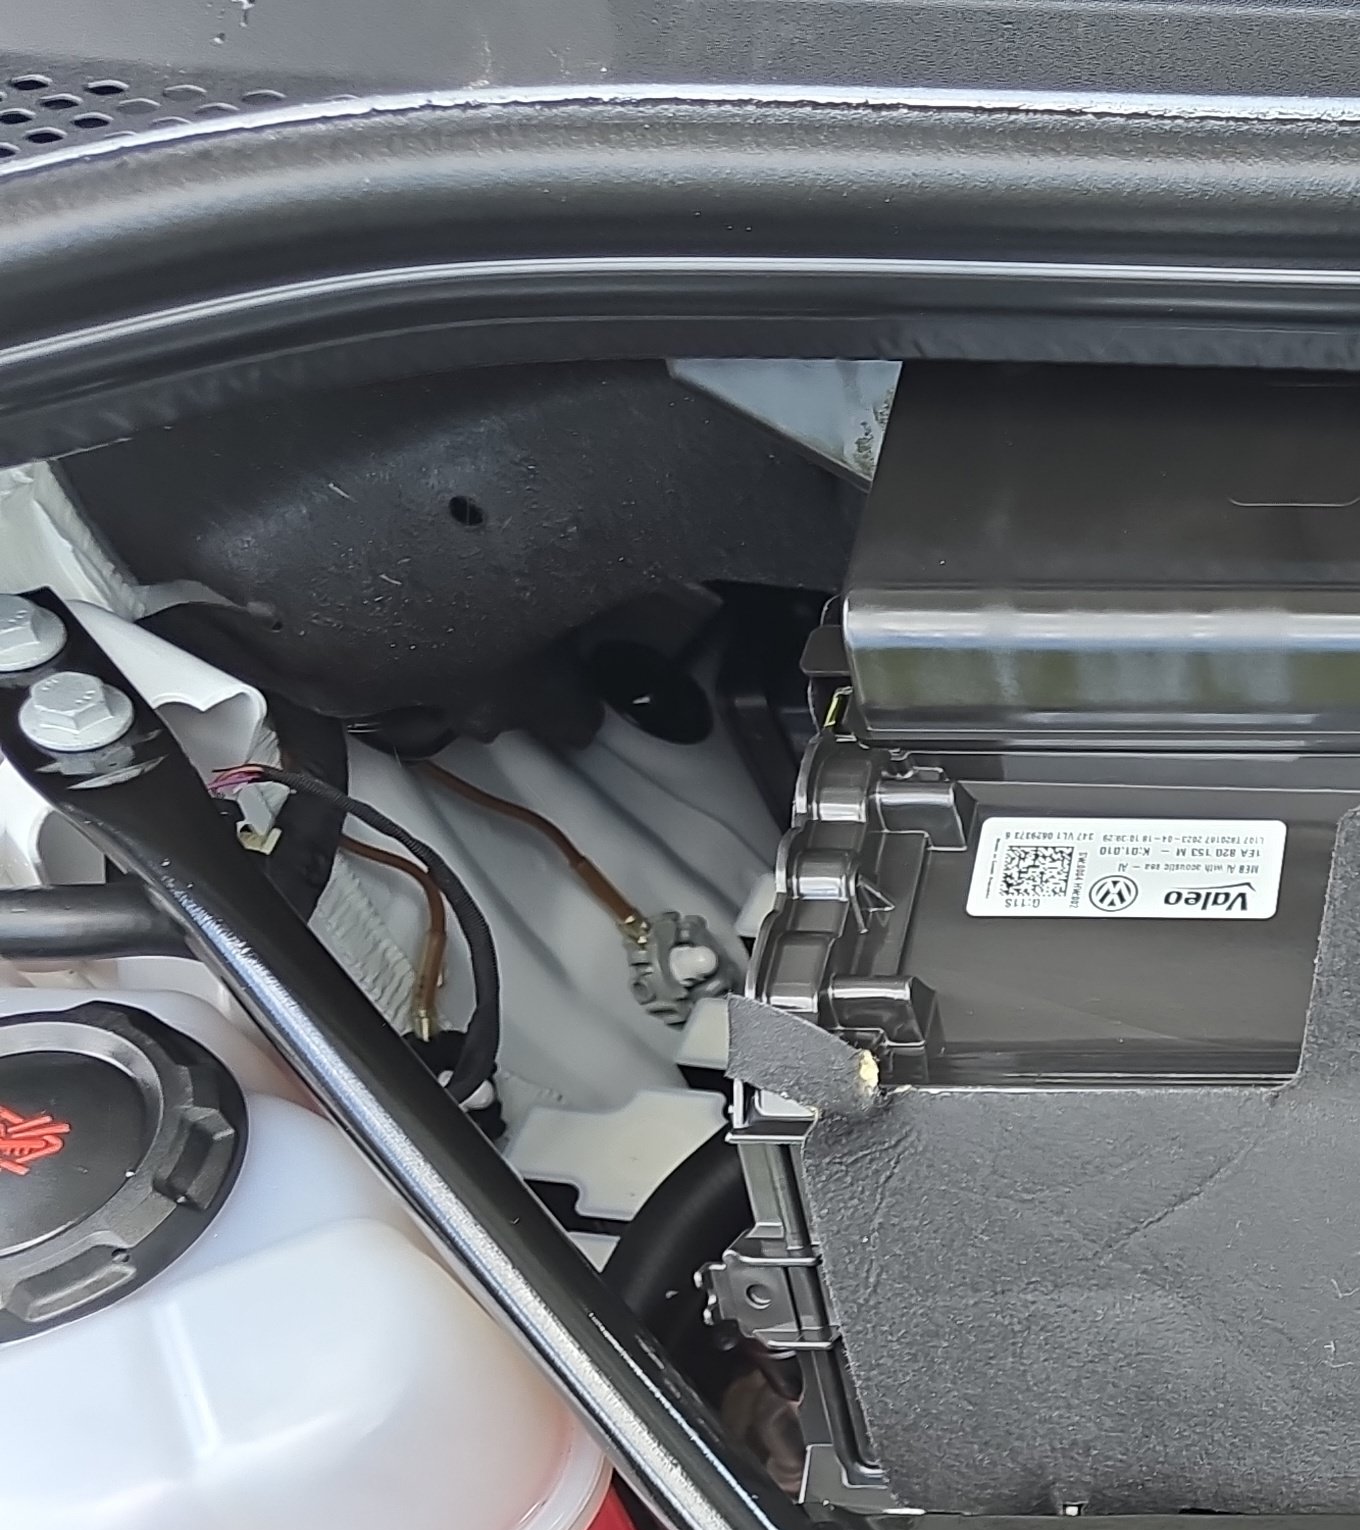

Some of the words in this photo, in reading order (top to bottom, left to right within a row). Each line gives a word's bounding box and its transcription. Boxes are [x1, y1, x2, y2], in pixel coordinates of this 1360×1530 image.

[1176, 848, 1187, 856] M
[1191, 848, 1210, 856] 153
[1216, 848, 1236, 857] 820
[1163, 890, 1248, 912] Valeo
